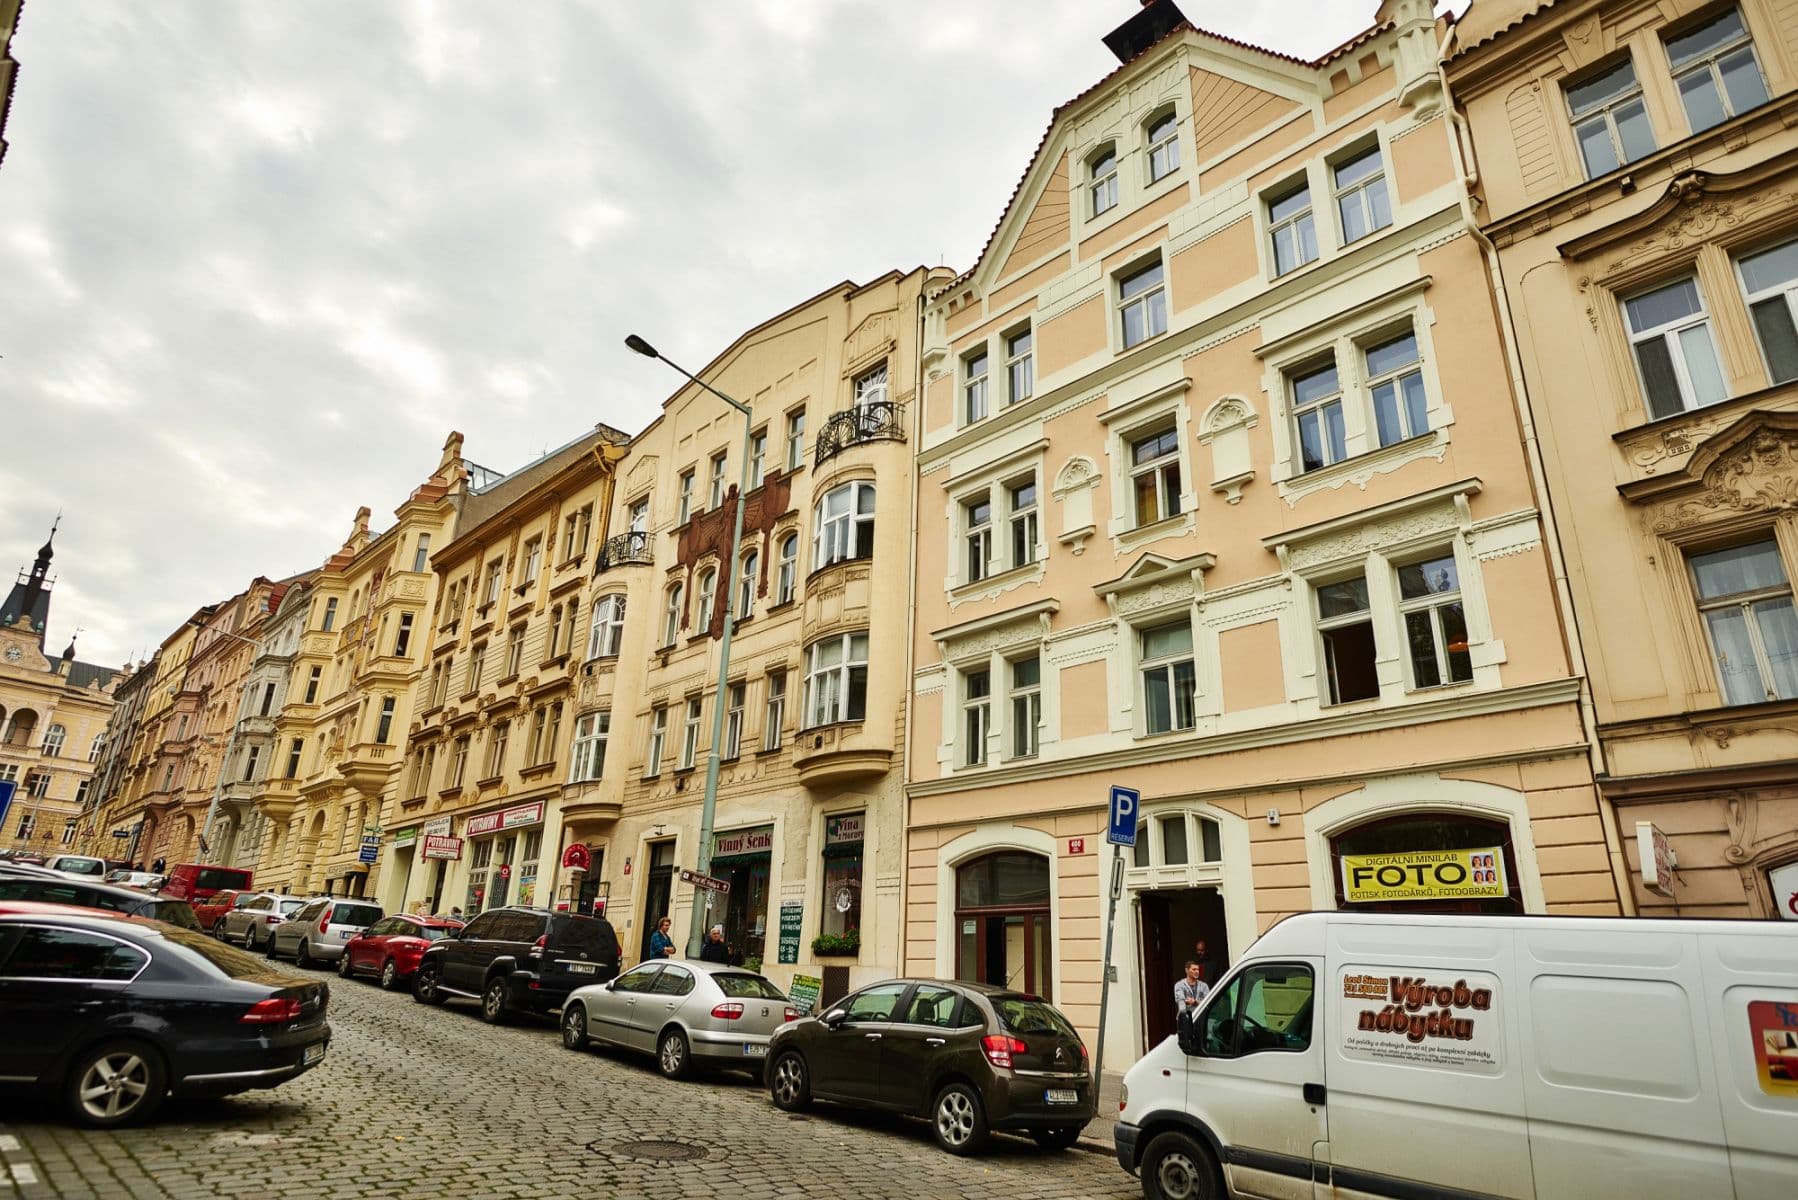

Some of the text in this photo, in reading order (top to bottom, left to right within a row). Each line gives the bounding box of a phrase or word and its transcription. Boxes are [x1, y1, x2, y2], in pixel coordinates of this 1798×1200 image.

[1116, 794, 1133, 826] P
[468, 814, 500, 834] POTRAVINY
[838, 819, 859, 831] Vína
[426, 836, 460, 849] POTRAVINY
[718, 832, 771, 853] Vinný Šenk
[1366, 853, 1458, 866] DIGITÁLNÍ MINILAB
[1352, 862, 1467, 889] FOTO
[1351, 890, 1380, 899] POTISK
[1439, 887, 1498, 896] FOTOOBRAZY
[1389, 976, 1492, 1013] Výroba
[1357, 1004, 1475, 1043] nábytku
